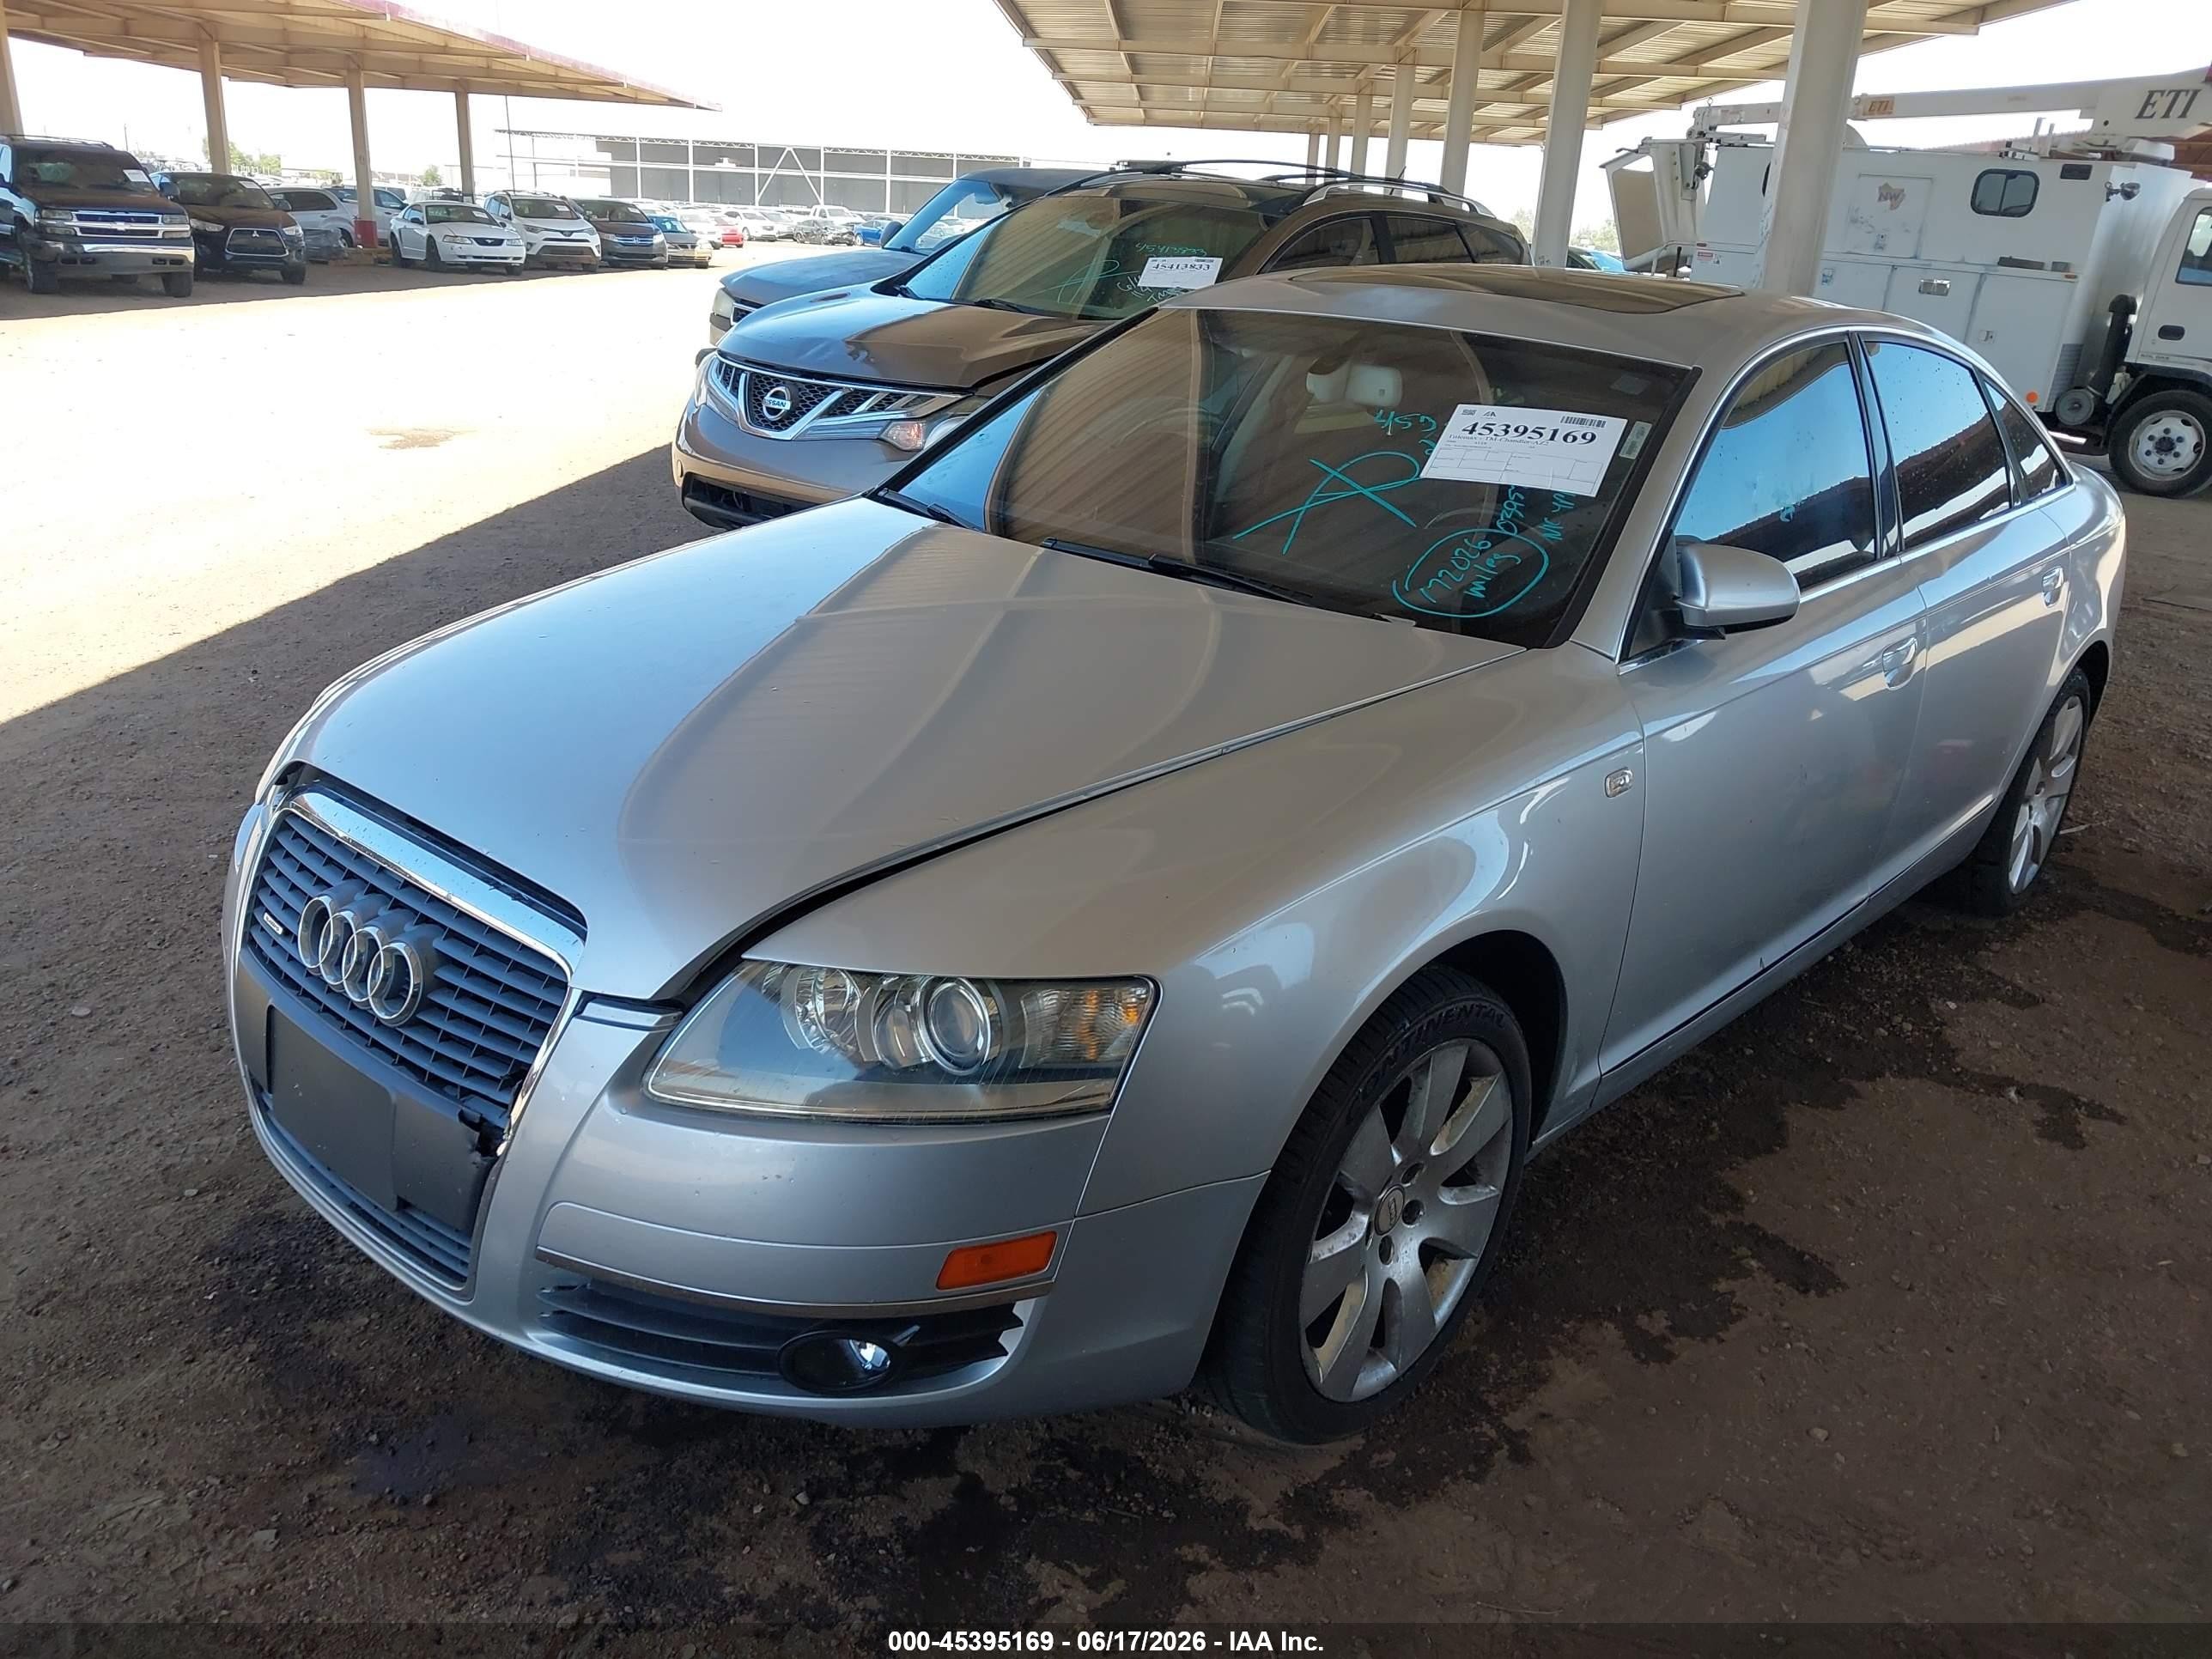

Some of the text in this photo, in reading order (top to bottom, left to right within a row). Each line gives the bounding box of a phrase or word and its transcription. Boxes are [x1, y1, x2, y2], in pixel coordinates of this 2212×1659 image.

[2135, 88, 2203, 119] ETI
[1152, 263, 1210, 271] 45413833
[763, 398, 787, 408] NISSAN
[1461, 421, 1597, 446] 45395169
